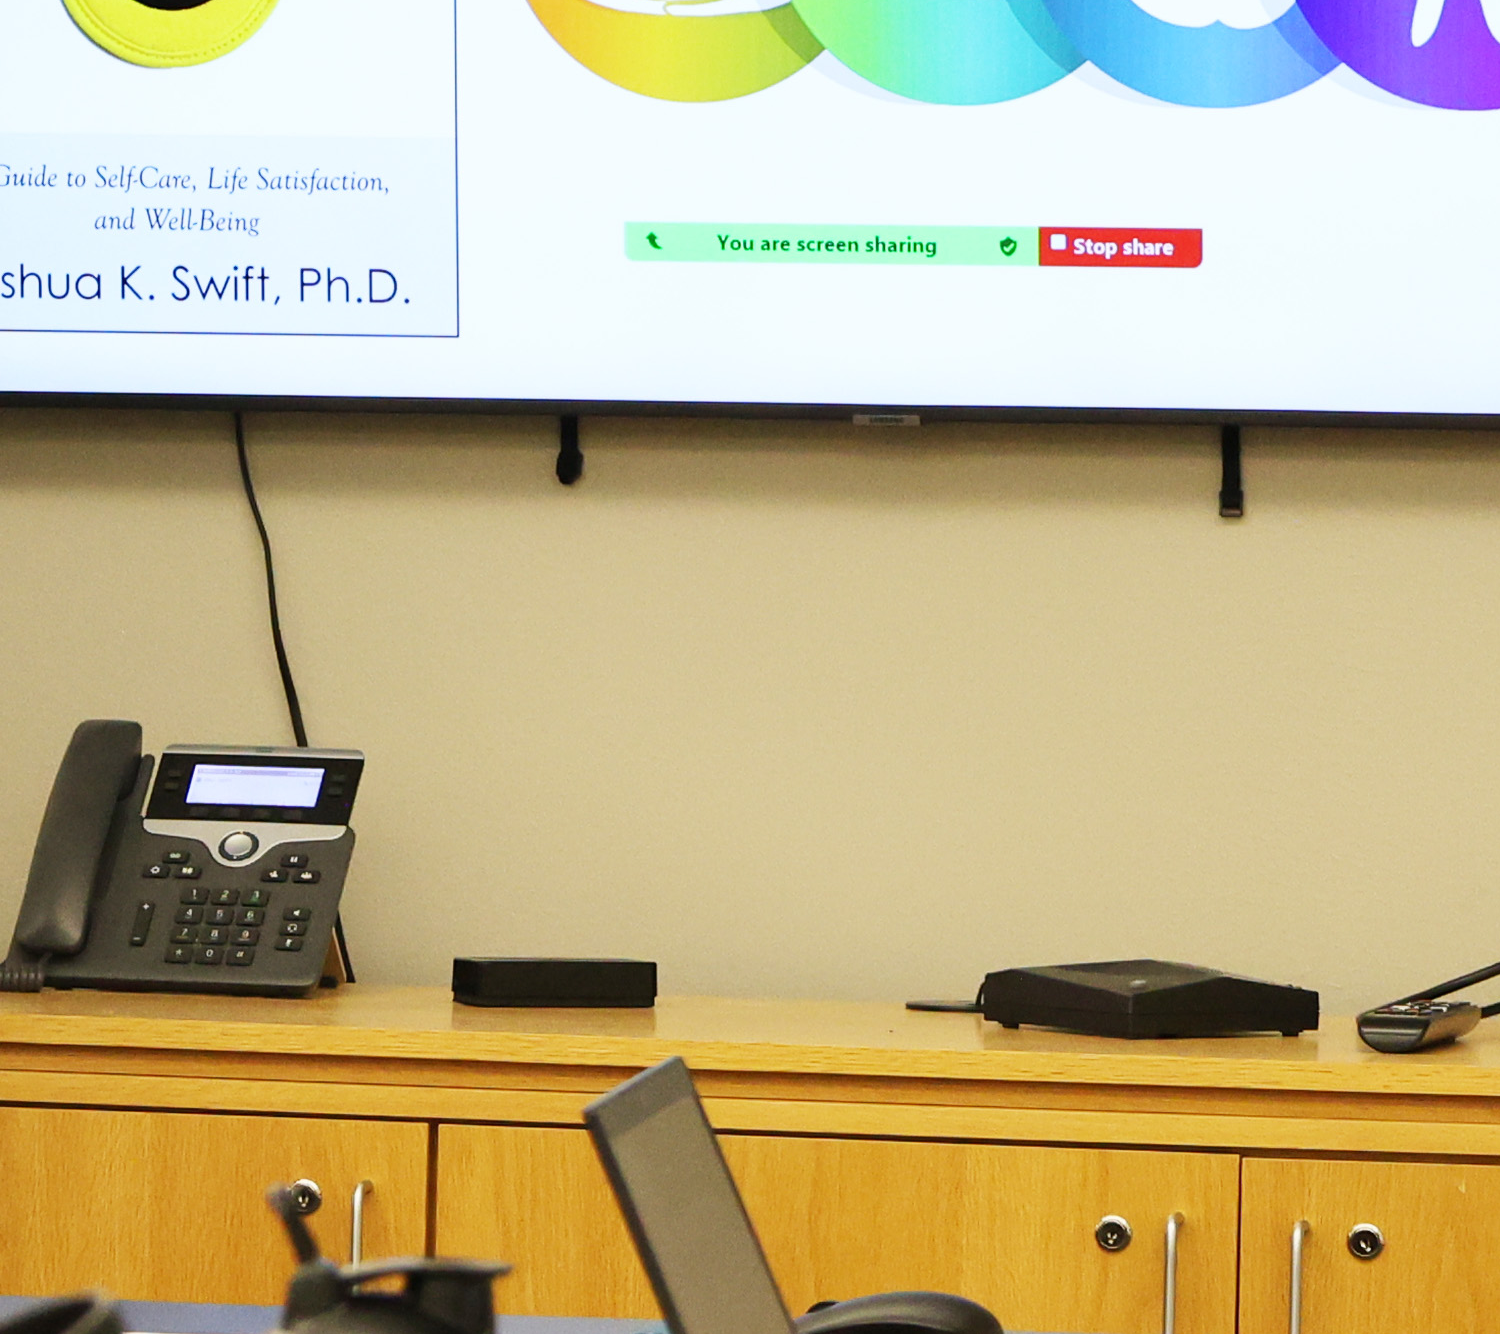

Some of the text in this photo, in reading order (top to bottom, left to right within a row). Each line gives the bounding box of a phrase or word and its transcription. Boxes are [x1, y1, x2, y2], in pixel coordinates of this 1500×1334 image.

[68, 173, 86, 187] to
[95, 166, 196, 192] Self-Care,
[209, 167, 247, 193] Life
[257, 168, 388, 195] Satisfaction,
[95, 208, 258, 235] and Well-Being
[718, 235, 936, 257] You are screen sharing
[1074, 238, 1174, 259] Stop share
[121, 266, 154, 300] K.
[172, 266, 279, 305] Swift,
[300, 268, 409, 304] Ph.D.
